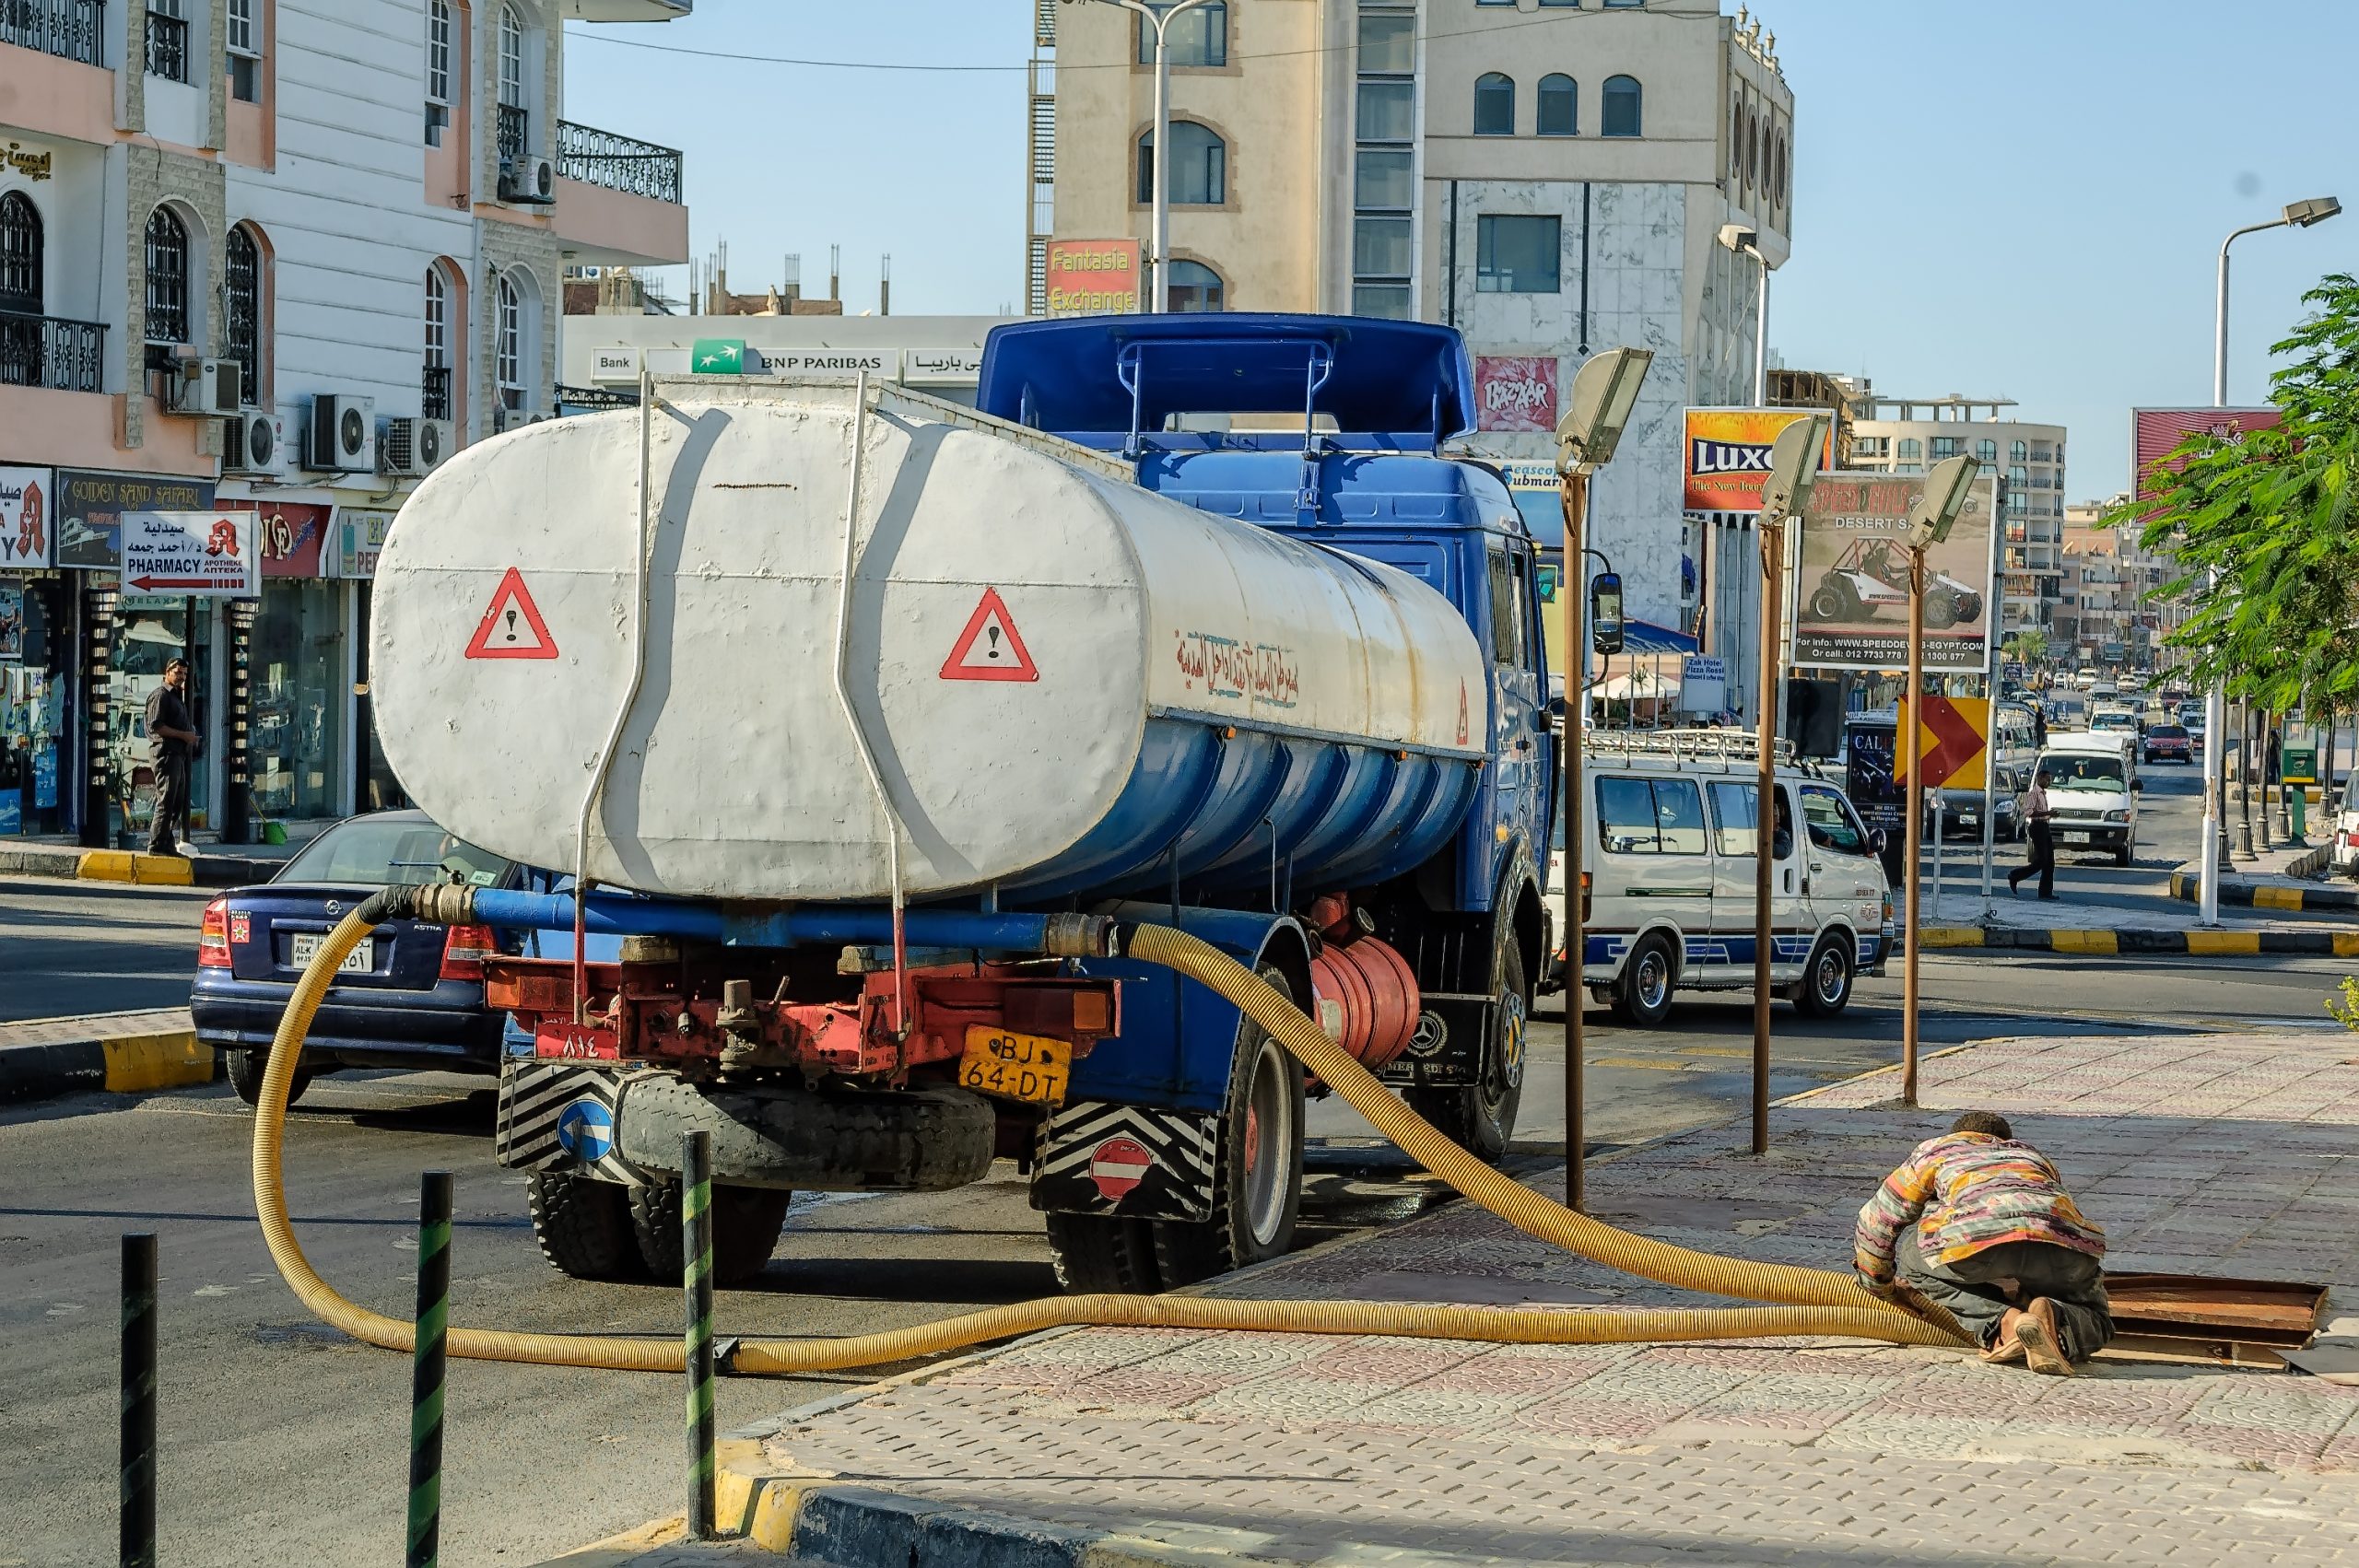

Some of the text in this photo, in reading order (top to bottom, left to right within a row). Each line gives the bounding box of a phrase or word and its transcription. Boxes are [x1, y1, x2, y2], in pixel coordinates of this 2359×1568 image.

[1051, 246, 1131, 272] Fantasia
[1051, 285, 1135, 314] Exchange
[600, 357, 630, 369] Bank
[761, 357, 882, 369] BNP PARIBAS
[1485, 377, 1550, 413] BAZAAR
[72, 481, 200, 508] GOLDEN SAND SAFARI
[143, 521, 184, 536] صيدلية
[1835, 517, 1895, 530] DESERT
[128, 558, 201, 573] PHARMACY
[1812, 649, 1824, 658] Or
[1825, 649, 1843, 658] call:
[1000, 1035, 1034, 1064] BJ
